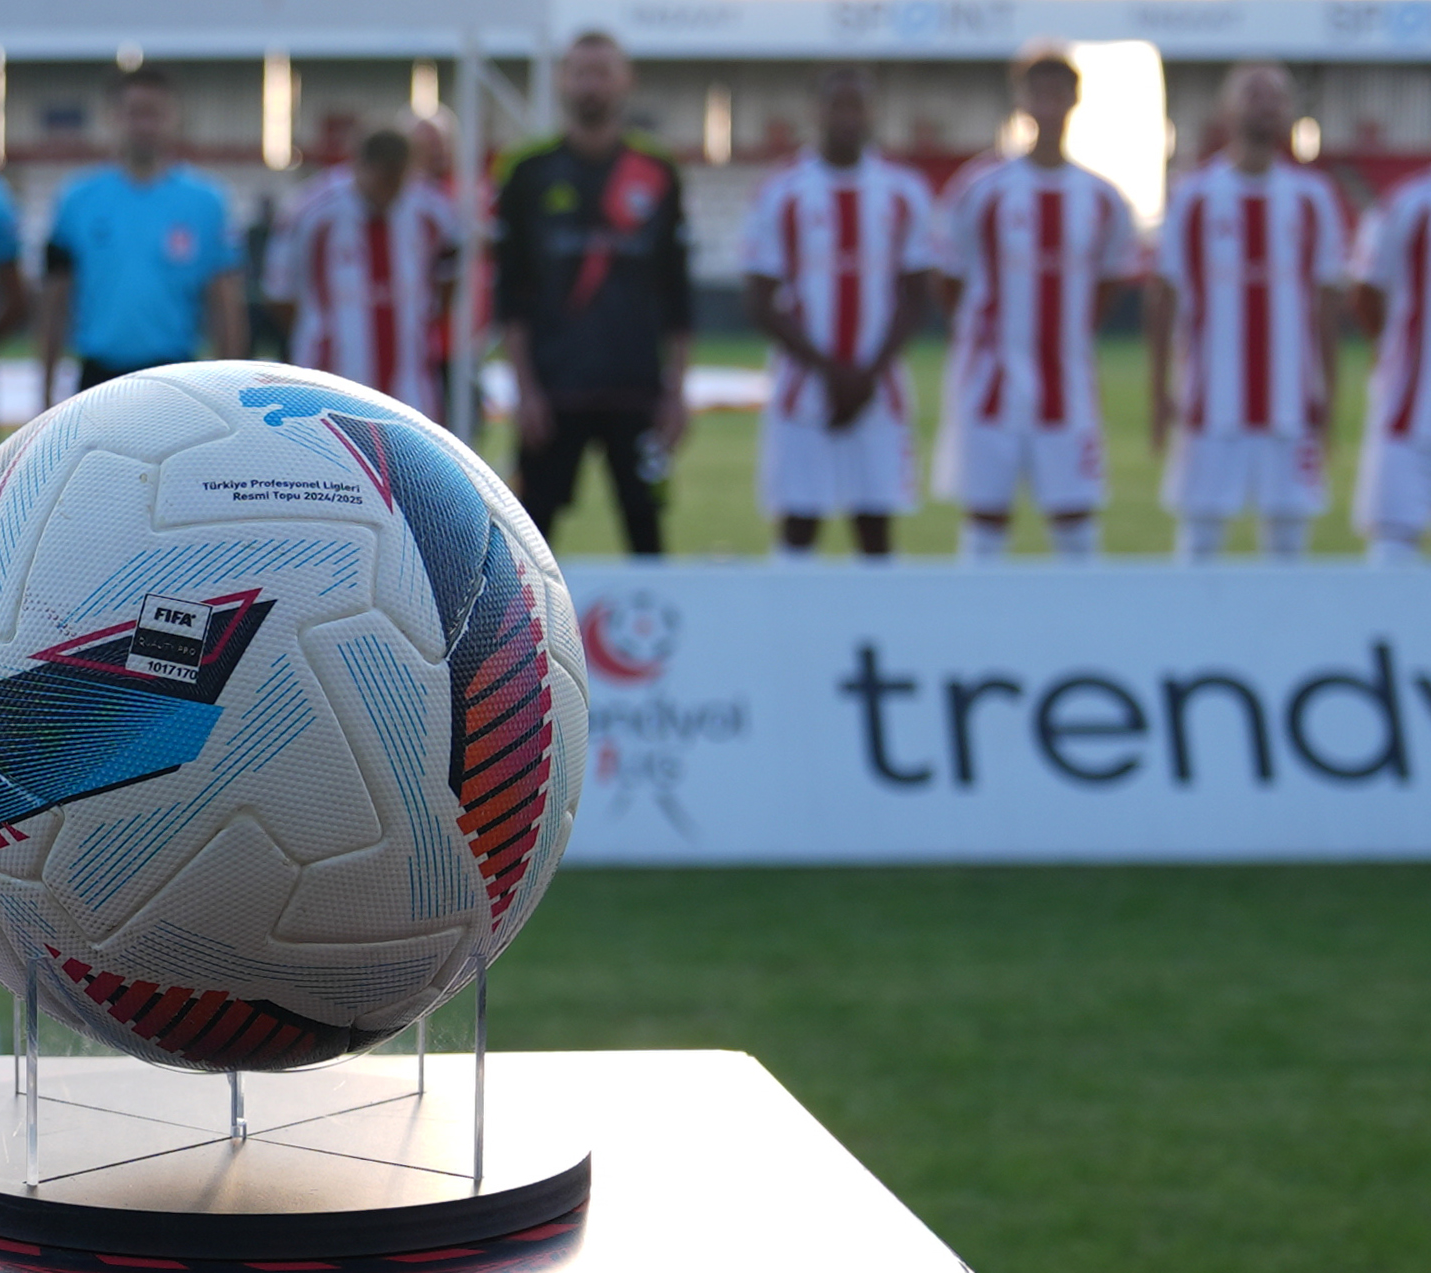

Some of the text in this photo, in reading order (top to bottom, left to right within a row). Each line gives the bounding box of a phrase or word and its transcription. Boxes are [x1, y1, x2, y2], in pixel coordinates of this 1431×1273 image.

[202, 479, 361, 494] Türkiye Profesyonel Ligleri
[233, 491, 364, 505] Resmi Topu 2024/2025
[154, 607, 193, 628] FIFA
[148, 660, 198, 681] 1017170
